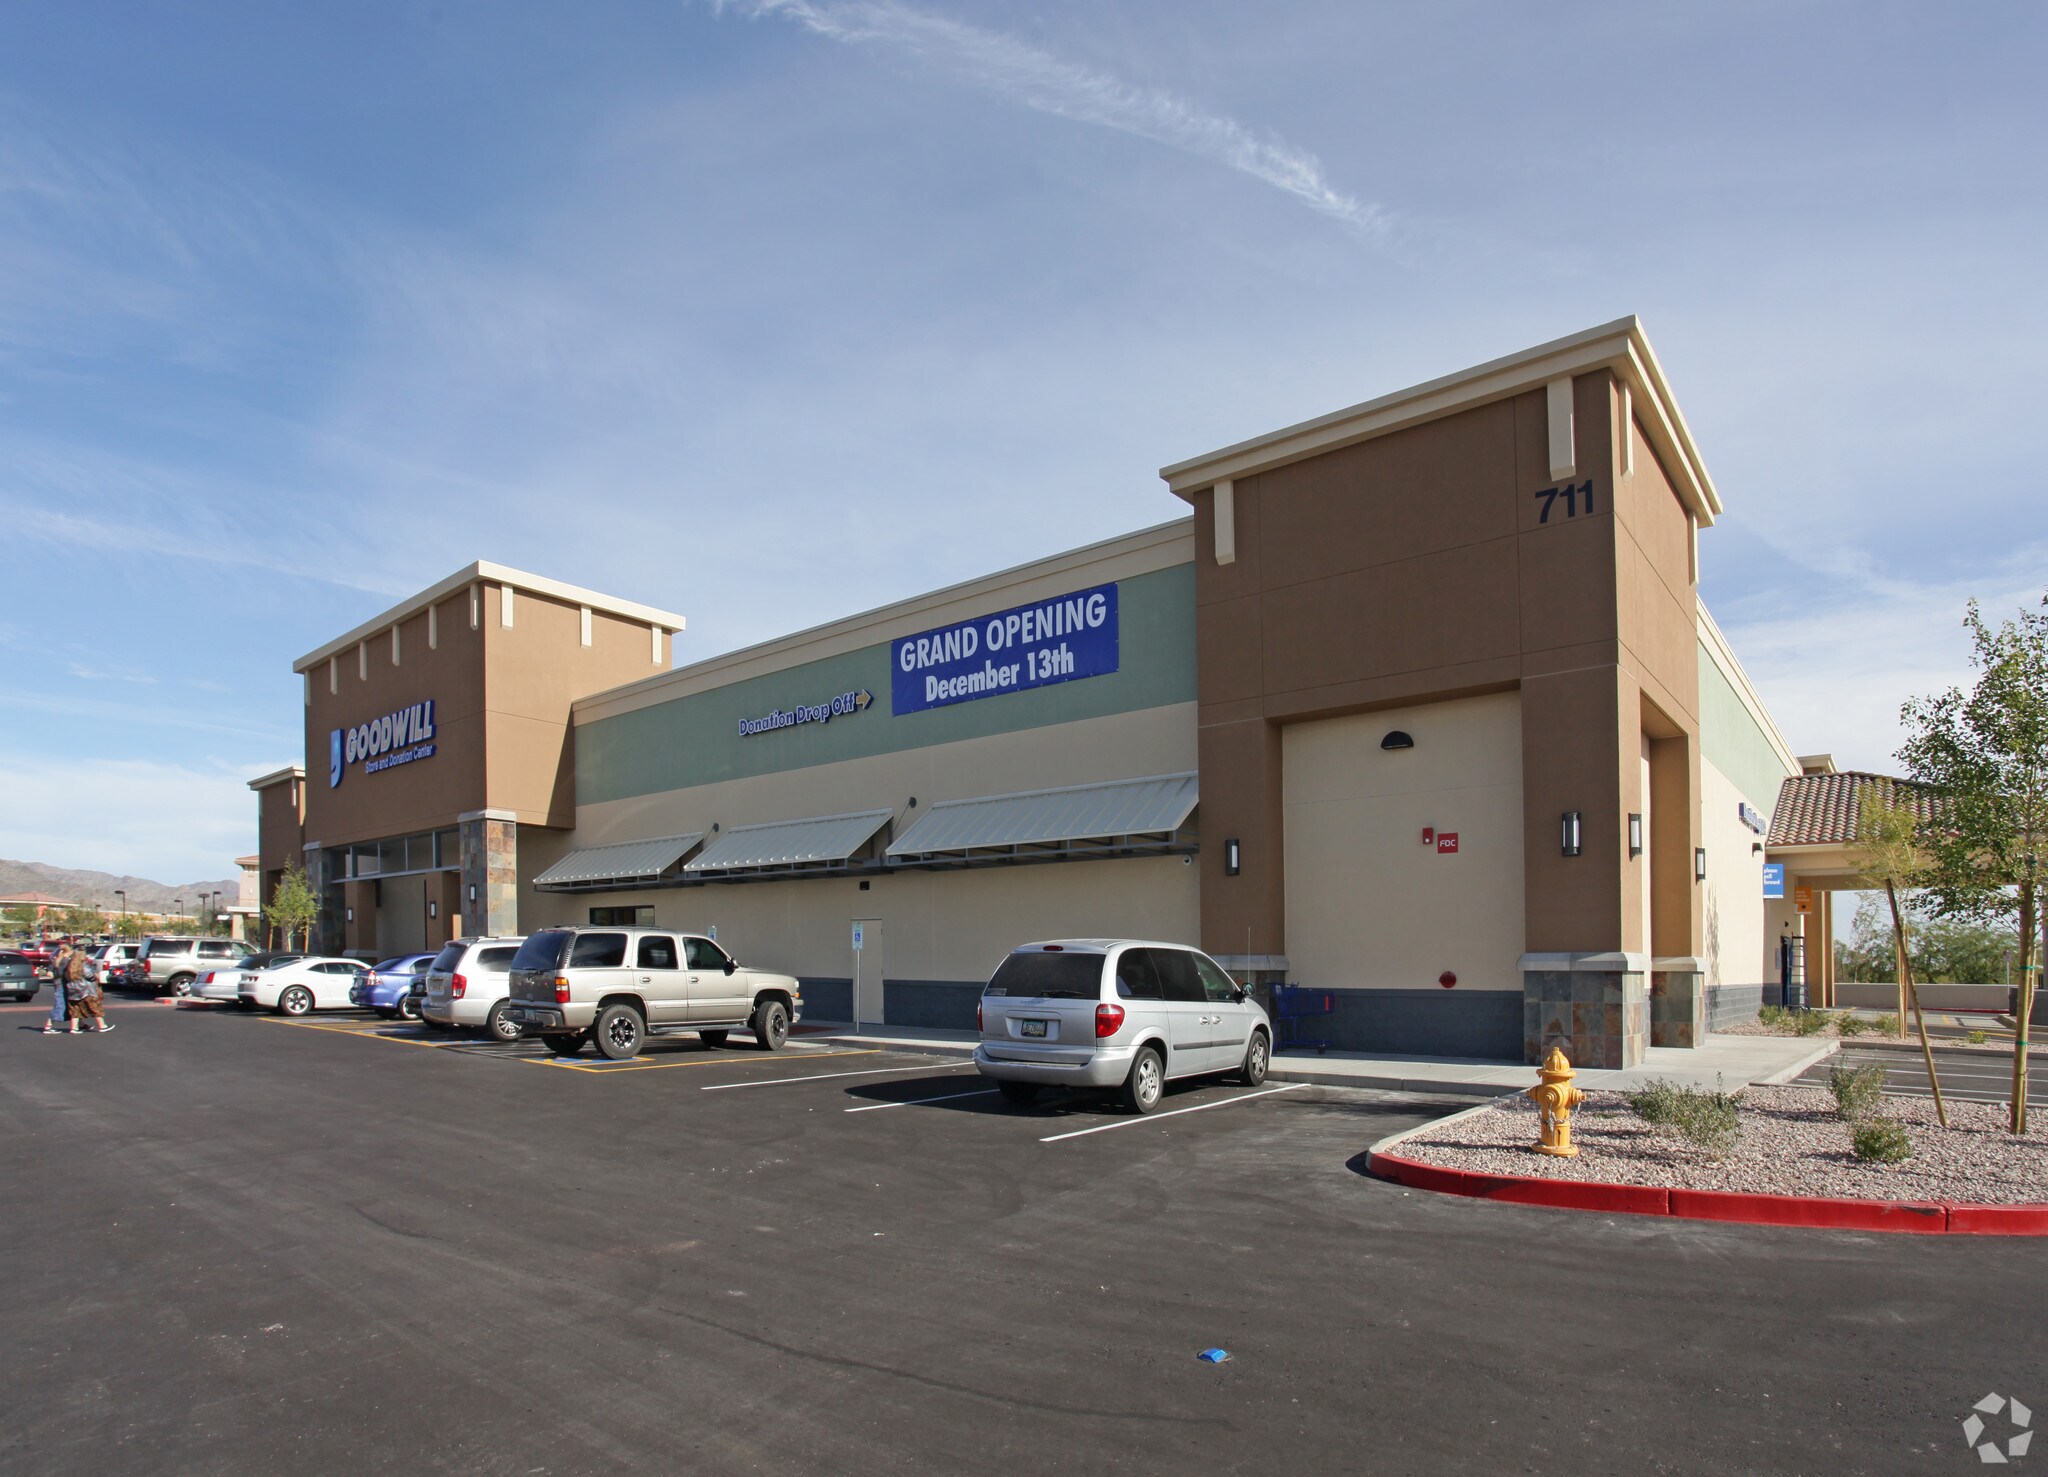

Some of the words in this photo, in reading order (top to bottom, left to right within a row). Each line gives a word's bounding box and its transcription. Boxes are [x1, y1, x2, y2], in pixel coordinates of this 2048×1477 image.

[1535, 479, 1594, 524] 711
[900, 626, 979, 672] GRAND
[986, 593, 1107, 651] OPENING
[925, 660, 1020, 702] December
[1027, 642, 1075, 681] 13th
[345, 700, 435, 764] GOODWILL
[739, 709, 794, 736] Donation
[796, 703, 830, 723] Drop
[832, 692, 856, 715] Off
[366, 760, 379, 774] Store
[379, 756, 389, 770] and
[389, 750, 413, 767] Donation
[413, 744, 433, 760] Center
[1439, 839, 1457, 848] FDC
